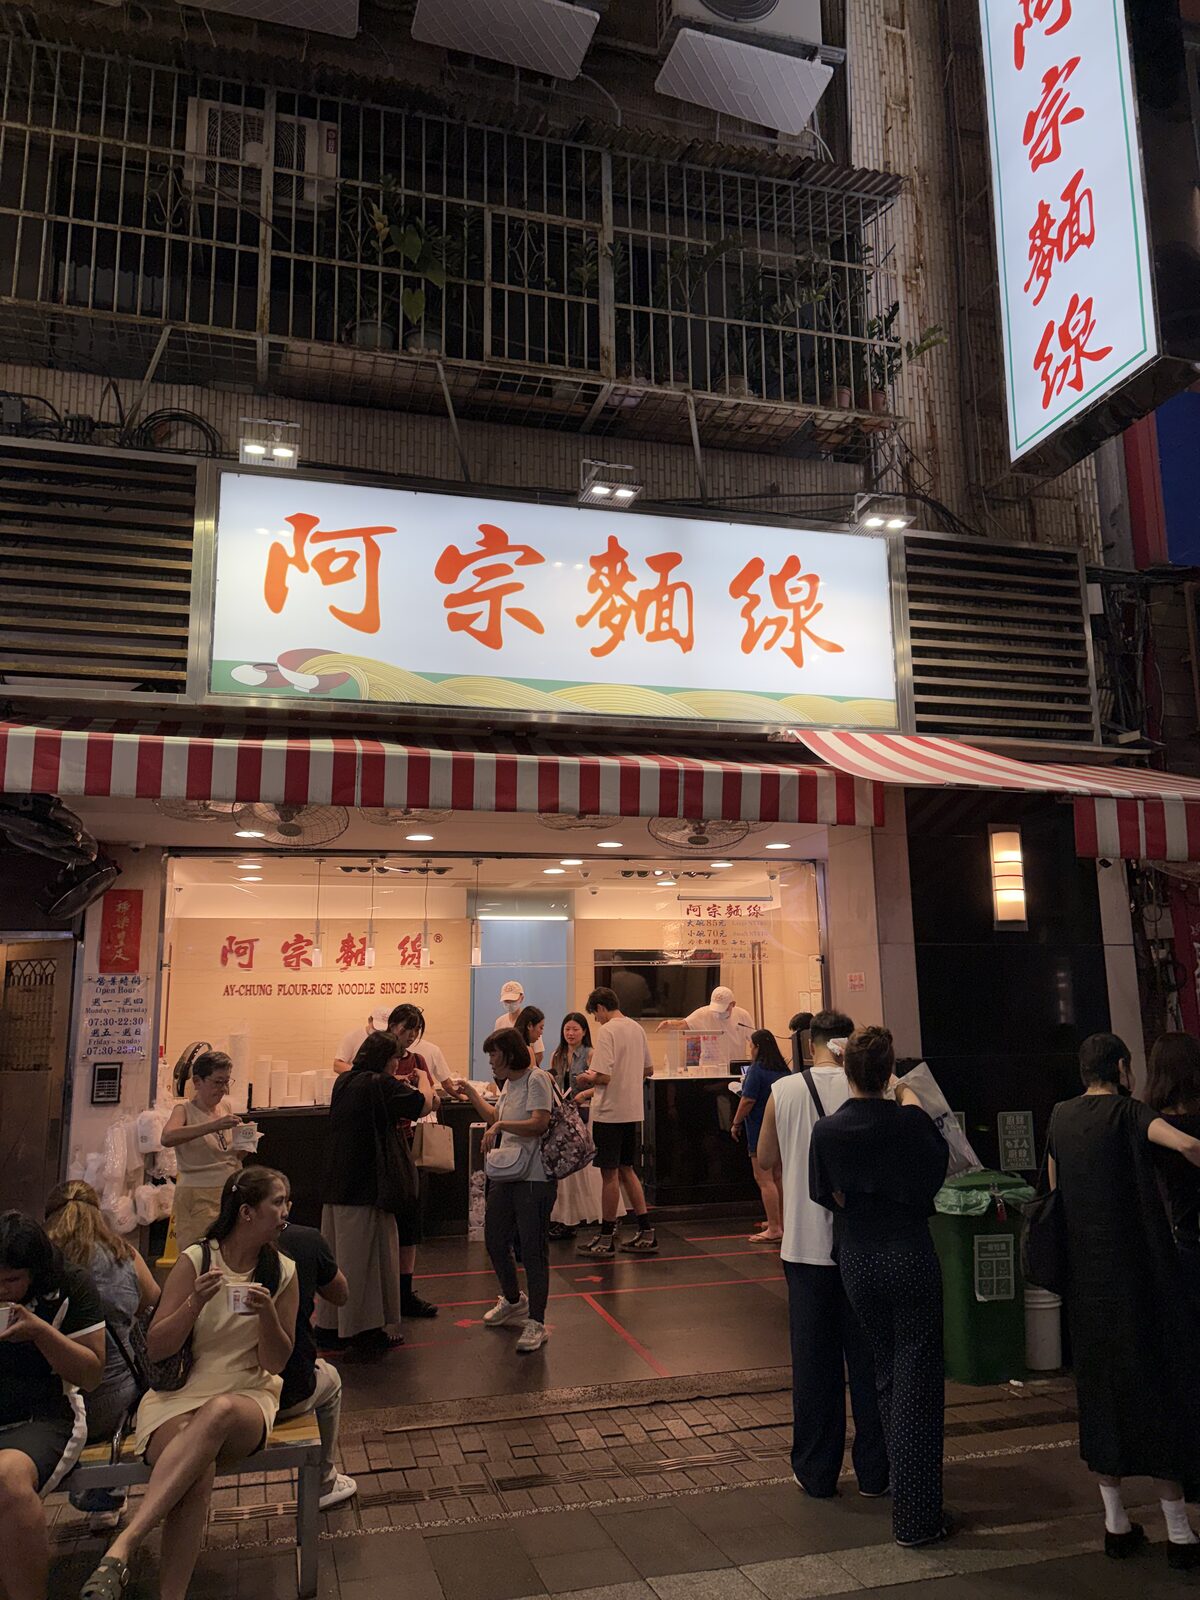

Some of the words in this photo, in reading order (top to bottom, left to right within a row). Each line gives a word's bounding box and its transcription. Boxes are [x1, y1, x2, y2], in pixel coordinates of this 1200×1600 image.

[264, 513, 844, 668] 阿宗麵線
[686, 904, 764, 918] 阿宗麵線
[687, 929, 727, 937] 小碗70元
[96, 976, 141, 986] 營業時間
[96, 987, 116, 995] Open
[223, 984, 273, 997] AY-CHUNG
[277, 984, 333, 996] FLOUR-RICE
[338, 983, 376, 995] NOODLE
[380, 982, 407, 994] SINCE
[409, 982, 429, 994] 1975
